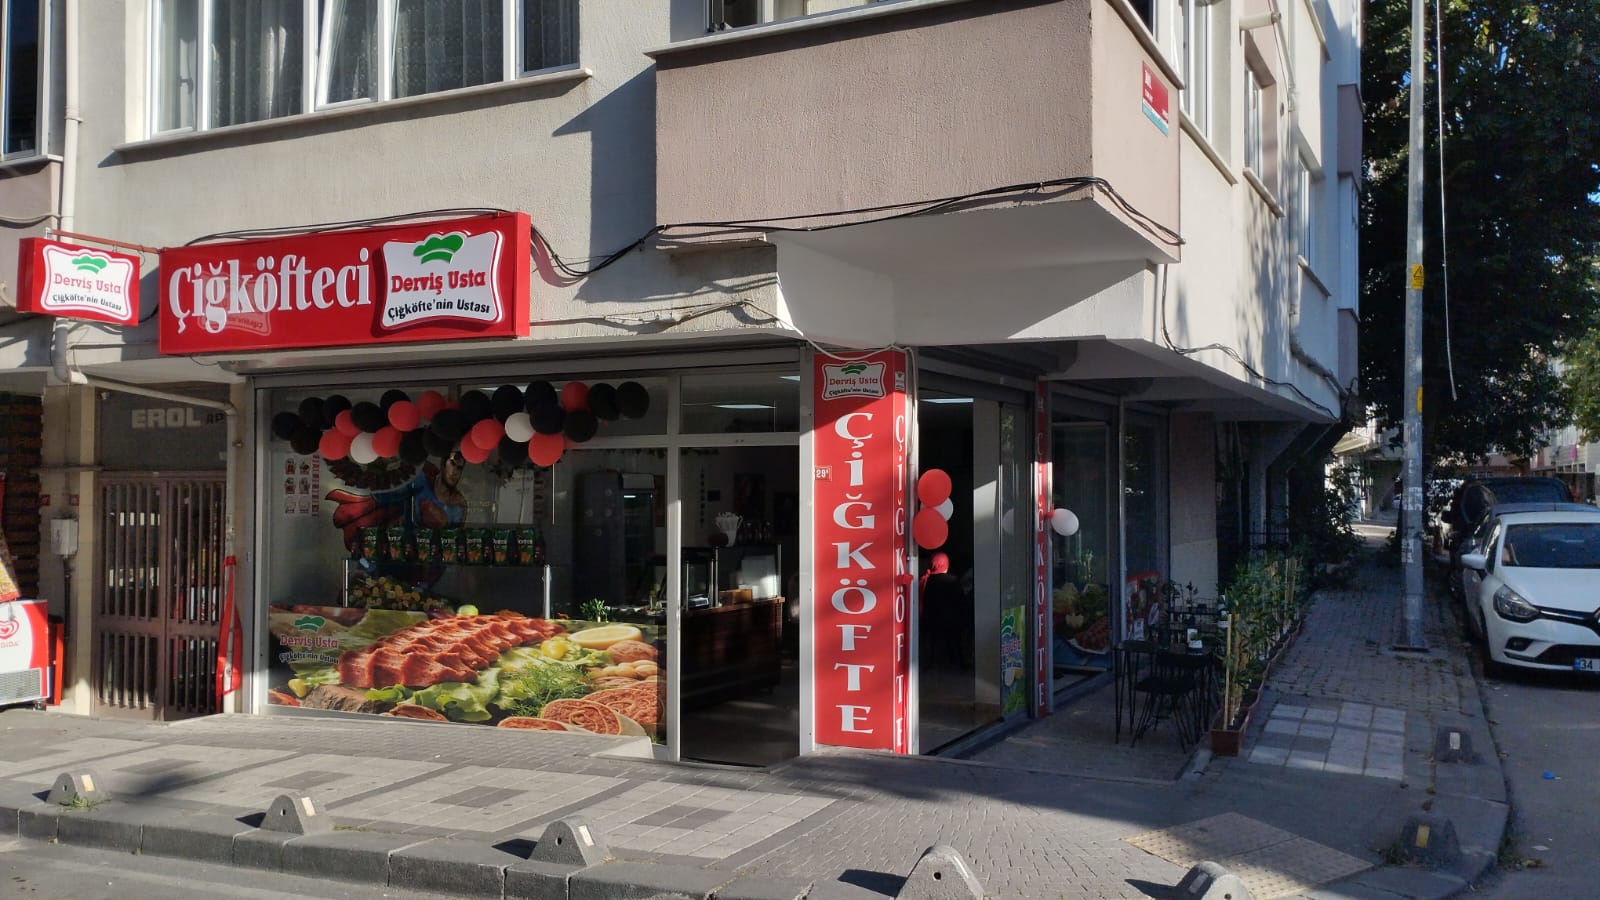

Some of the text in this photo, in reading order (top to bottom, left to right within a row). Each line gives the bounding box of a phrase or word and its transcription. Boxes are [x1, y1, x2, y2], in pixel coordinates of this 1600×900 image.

[54, 272, 121, 294] Derviş Usta
[168, 247, 371, 334] Çiğköfteci
[391, 269, 486, 295] Derviş Usta
[457, 298, 490, 314] Ustası
[829, 376, 878, 387] Derviş Usta
[131, 407, 201, 429] EROL
[832, 412, 877, 734] ÇİĞKÖFTE
[315, 635, 339, 649] Usta
[1580, 659, 1593, 669] 34
